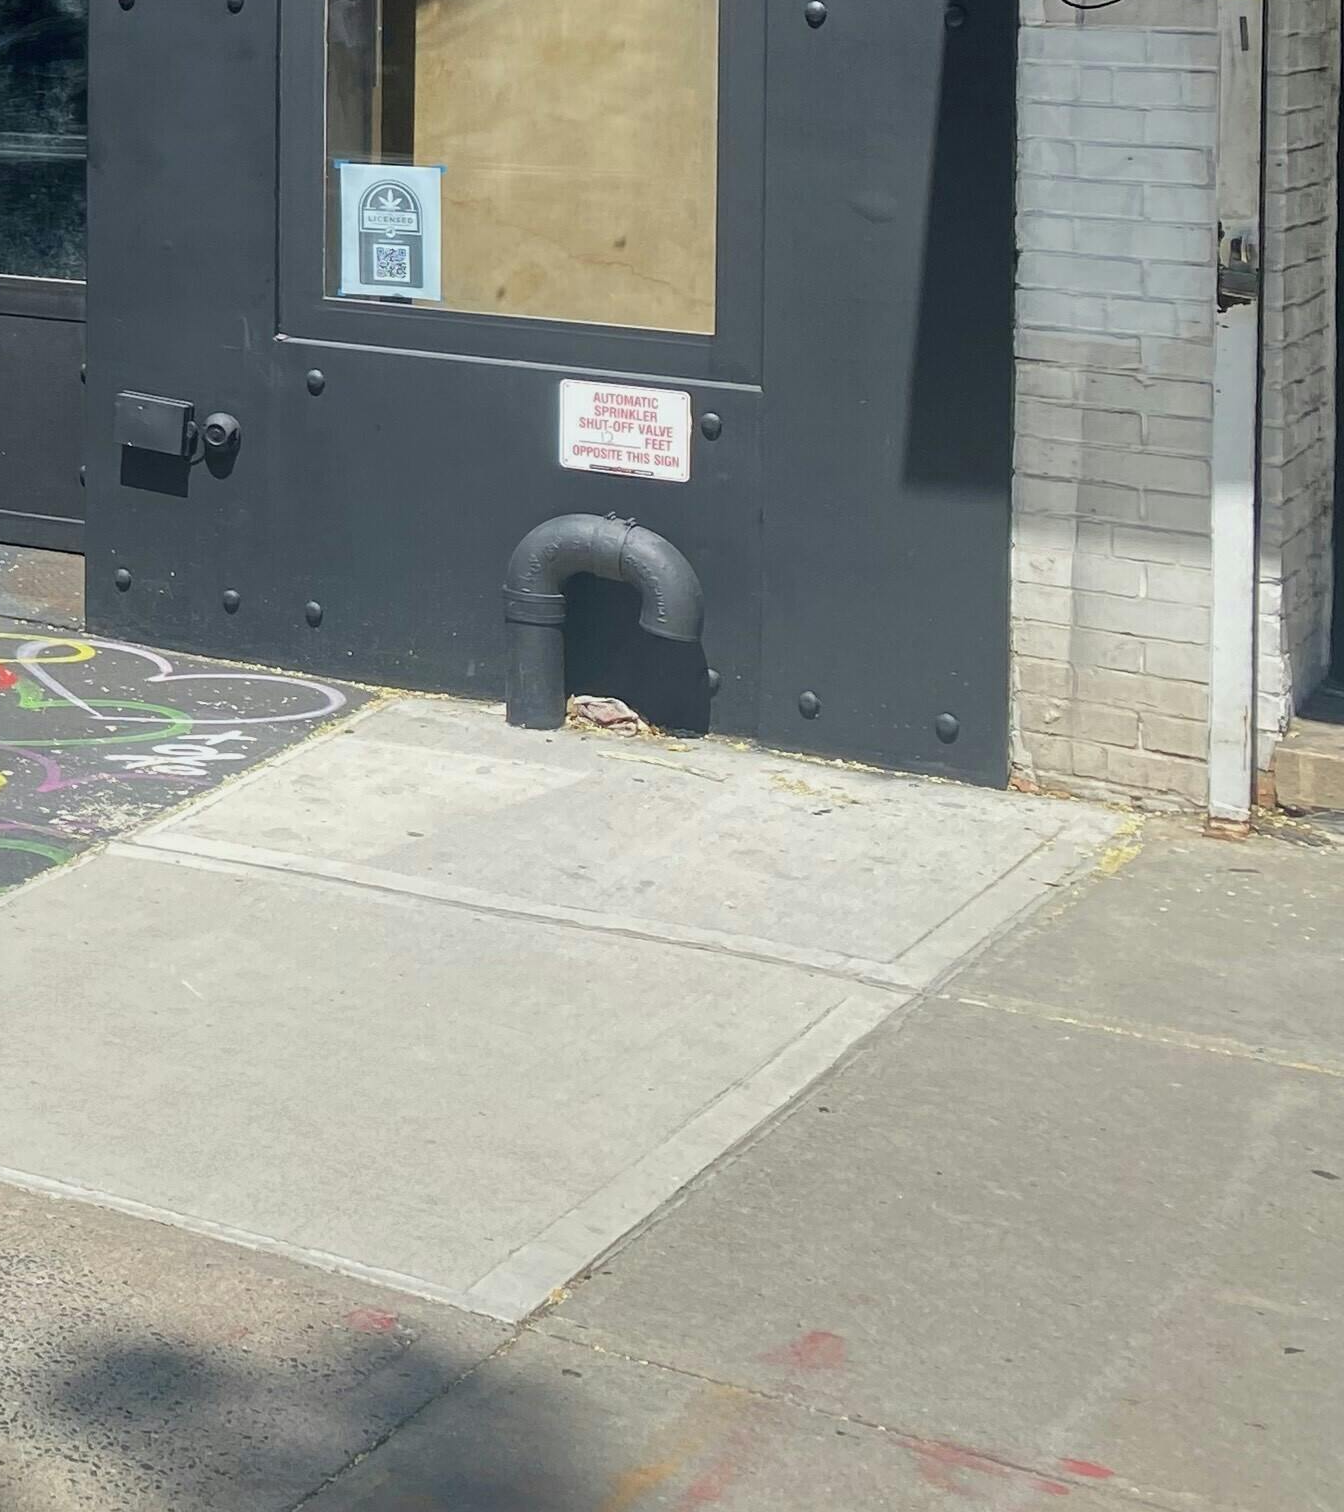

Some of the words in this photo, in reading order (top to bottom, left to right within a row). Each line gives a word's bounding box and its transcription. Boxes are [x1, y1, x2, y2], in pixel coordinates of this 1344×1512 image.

[368, 216, 414, 224] LICENSED
[593, 392, 659, 409] AUTOMATIC
[594, 406, 657, 423] SPRINKLER
[579, 418, 634, 434] SHUT-OFF
[639, 425, 673, 438] VALVE
[645, 439, 672, 451] FEET
[573, 445, 622, 461] OPPOSITE
[627, 452, 650, 465] THIS
[654, 455, 679, 468] SIGN
